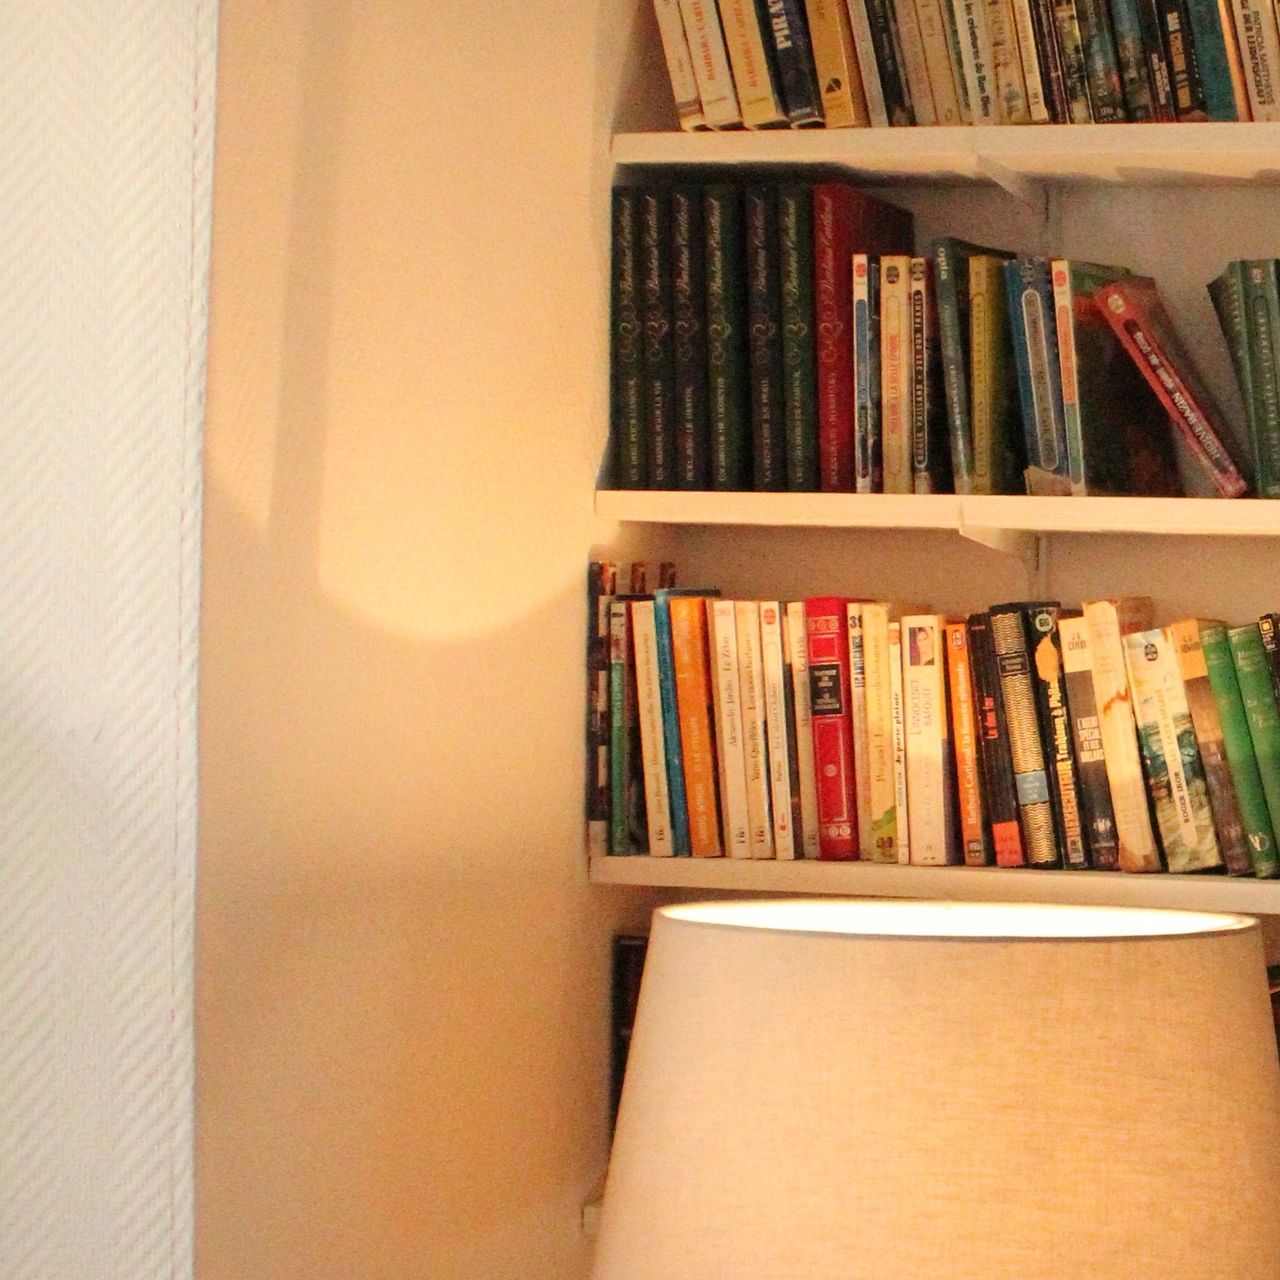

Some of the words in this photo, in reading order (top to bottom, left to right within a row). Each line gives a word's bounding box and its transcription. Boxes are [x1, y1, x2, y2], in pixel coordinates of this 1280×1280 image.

[1251, 10, 1264, 50] PATRICIA
[1259, 53, 1275, 105] MATTHEWS
[1174, 392, 1197, 423] BAZIN
[1054, 719, 1068, 759] Trahison
[965, 789, 976, 824] Barbara
[1180, 795, 1190, 823] ROGER
